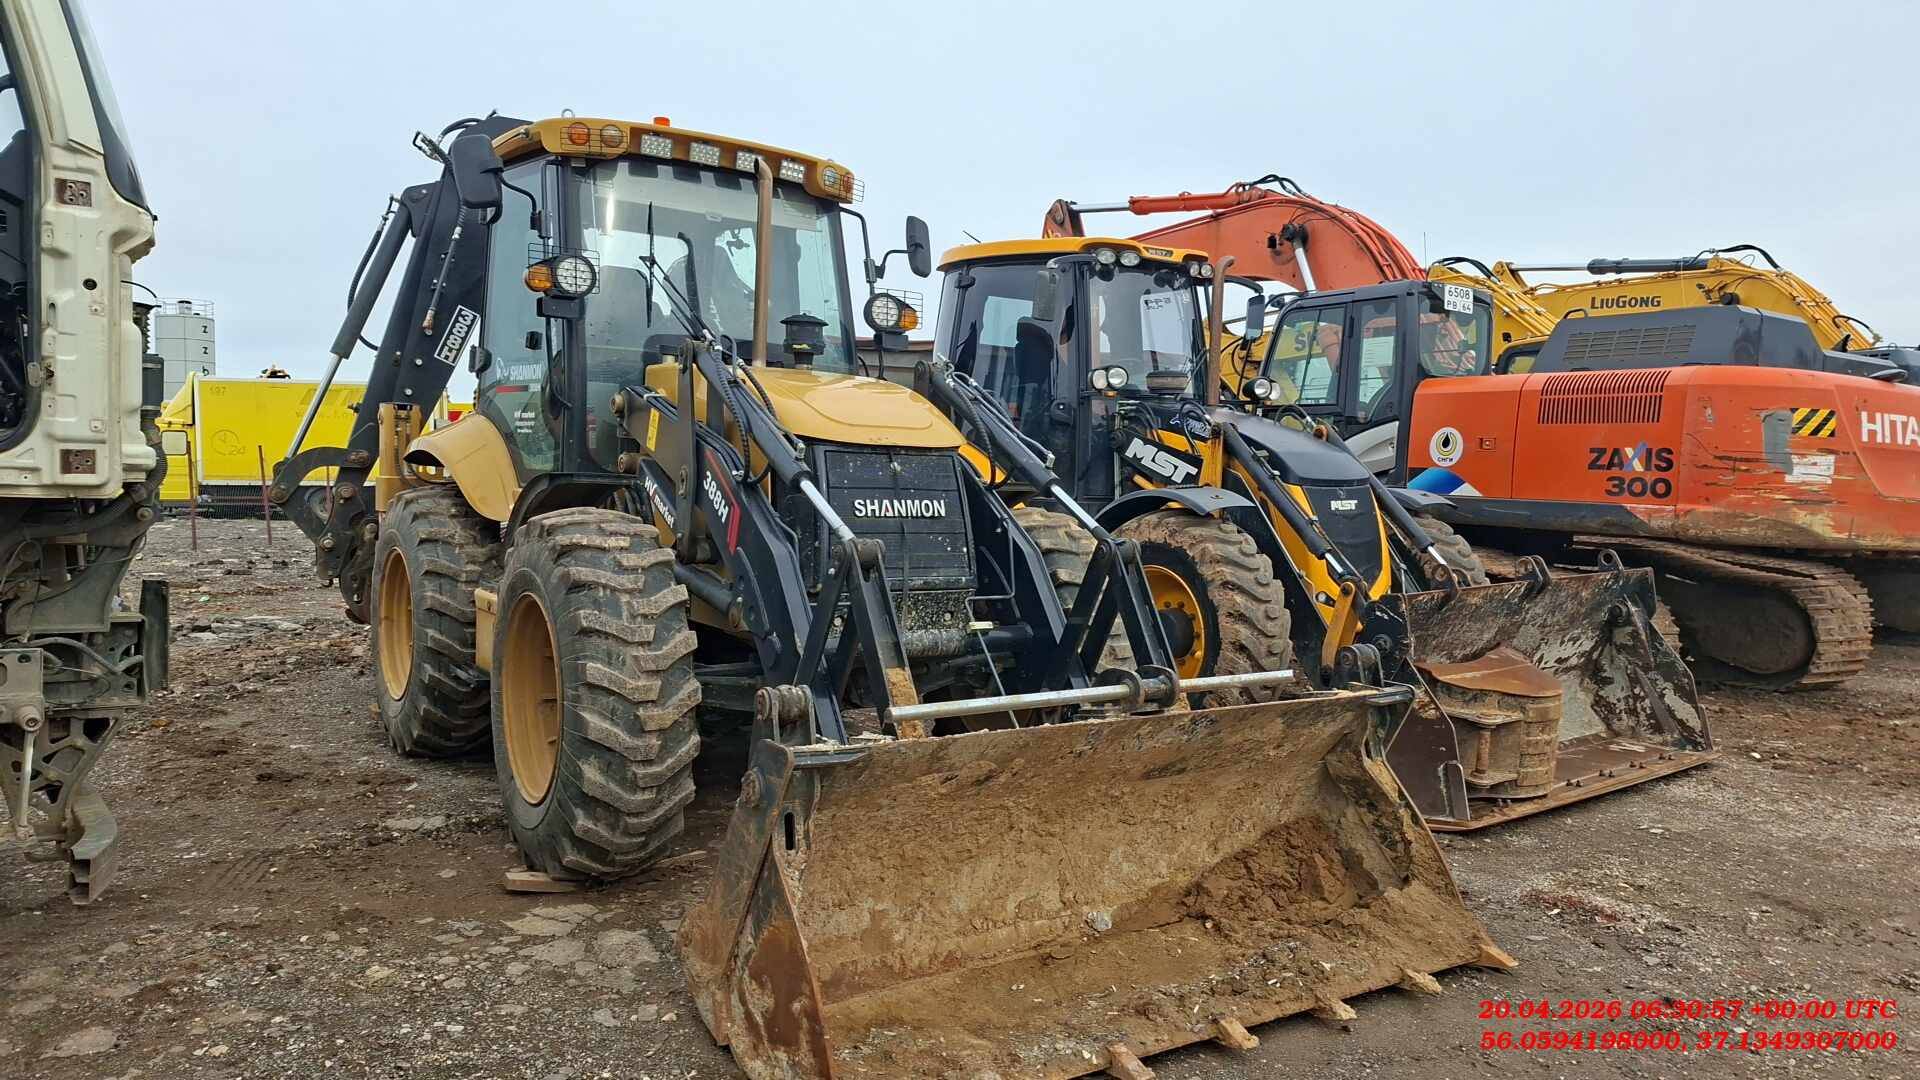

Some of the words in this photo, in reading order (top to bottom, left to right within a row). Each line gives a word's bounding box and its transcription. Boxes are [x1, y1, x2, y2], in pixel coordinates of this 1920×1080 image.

[1448, 286, 1470, 300] 6508
[1462, 303, 1471, 312] 64
[1125, 437, 1199, 484] MST
[1588, 440, 1674, 472] ZAXIS
[703, 470, 729, 523] 388H
[1604, 476, 1672, 499] 300
[854, 499, 946, 517] SHANMON
[1330, 499, 1358, 511] MST
